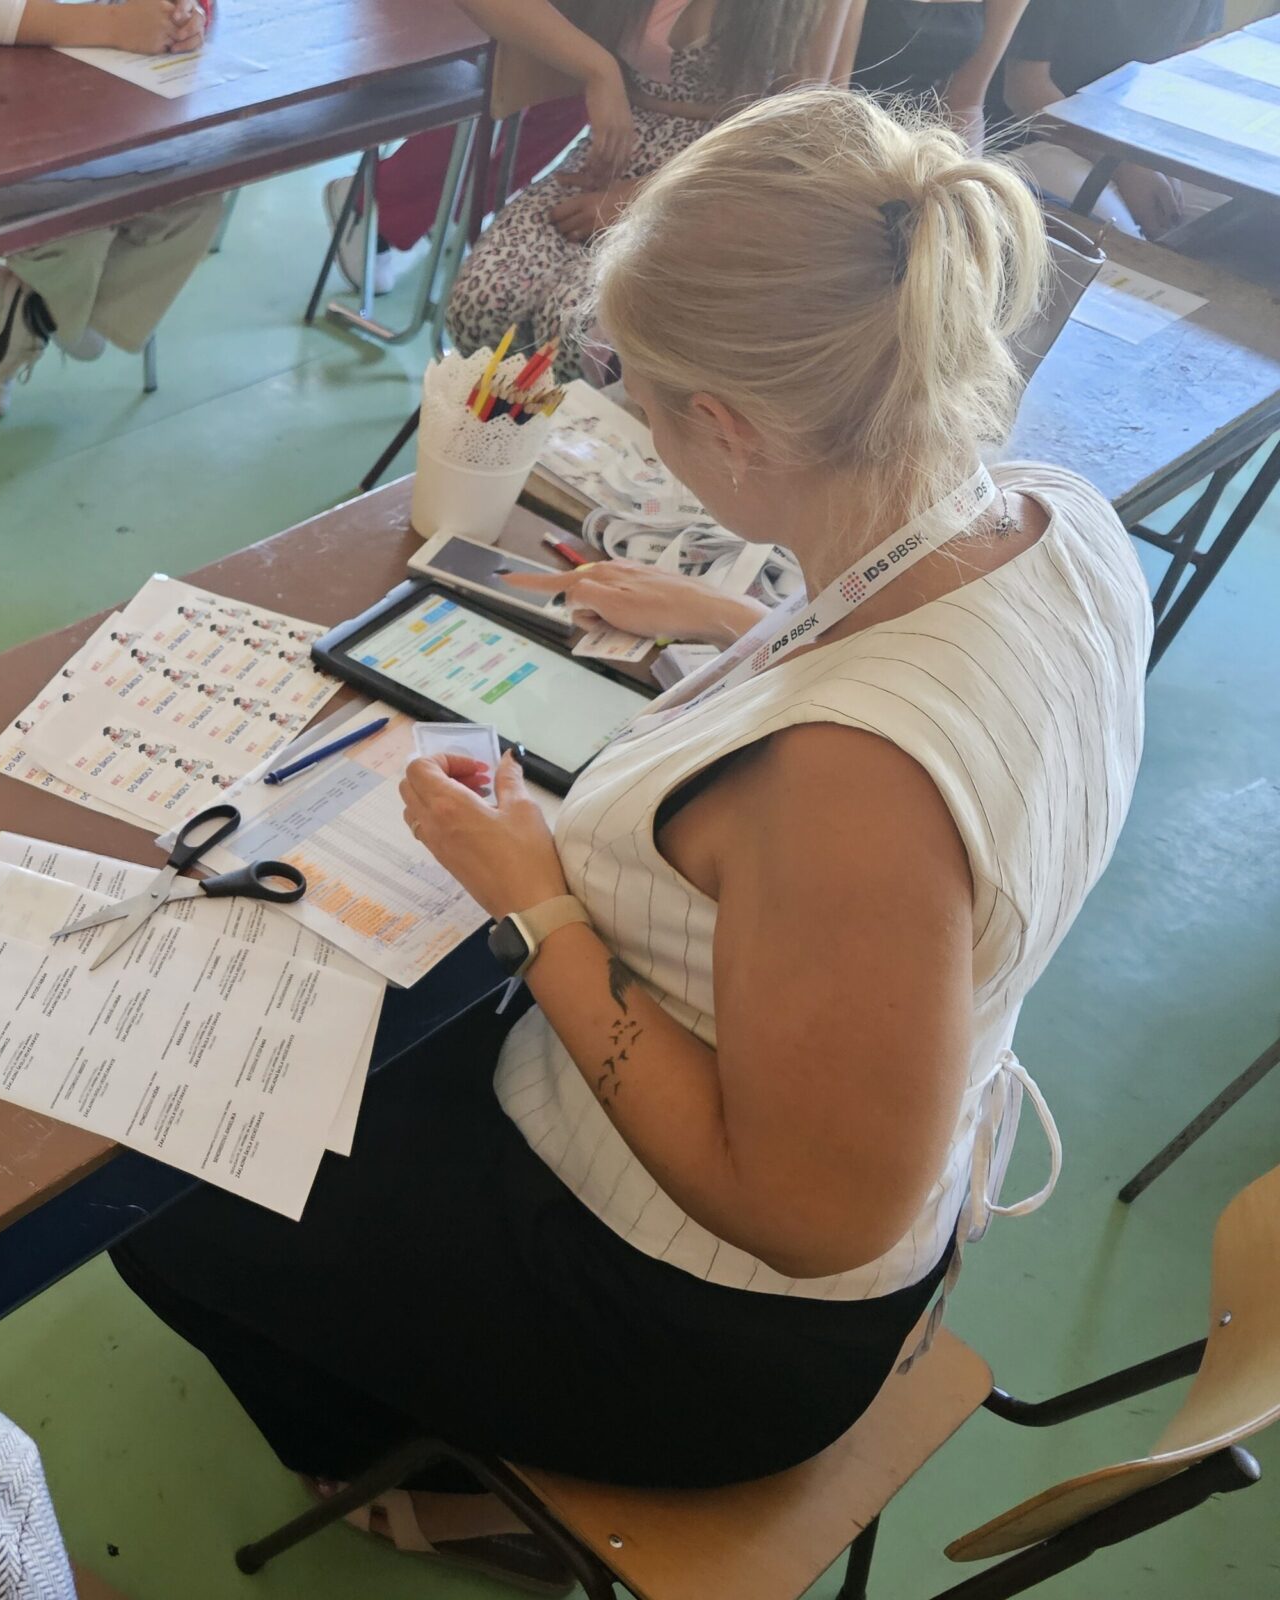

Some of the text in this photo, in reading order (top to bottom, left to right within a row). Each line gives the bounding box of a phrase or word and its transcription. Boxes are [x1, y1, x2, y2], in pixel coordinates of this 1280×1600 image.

[863, 533, 929, 582] IDS BBSK
[771, 613, 819, 653] IDS BBSK
[117, 687, 130, 697] DO
[151, 705, 164, 715] DO
[187, 719, 200, 729] DO
[223, 734, 236, 744] DO
[260, 749, 273, 759] DO
[4, 761, 16, 772] DO
[89, 766, 102, 777] DO
[126, 783, 138, 793] DO
[163, 798, 177, 810] DO
